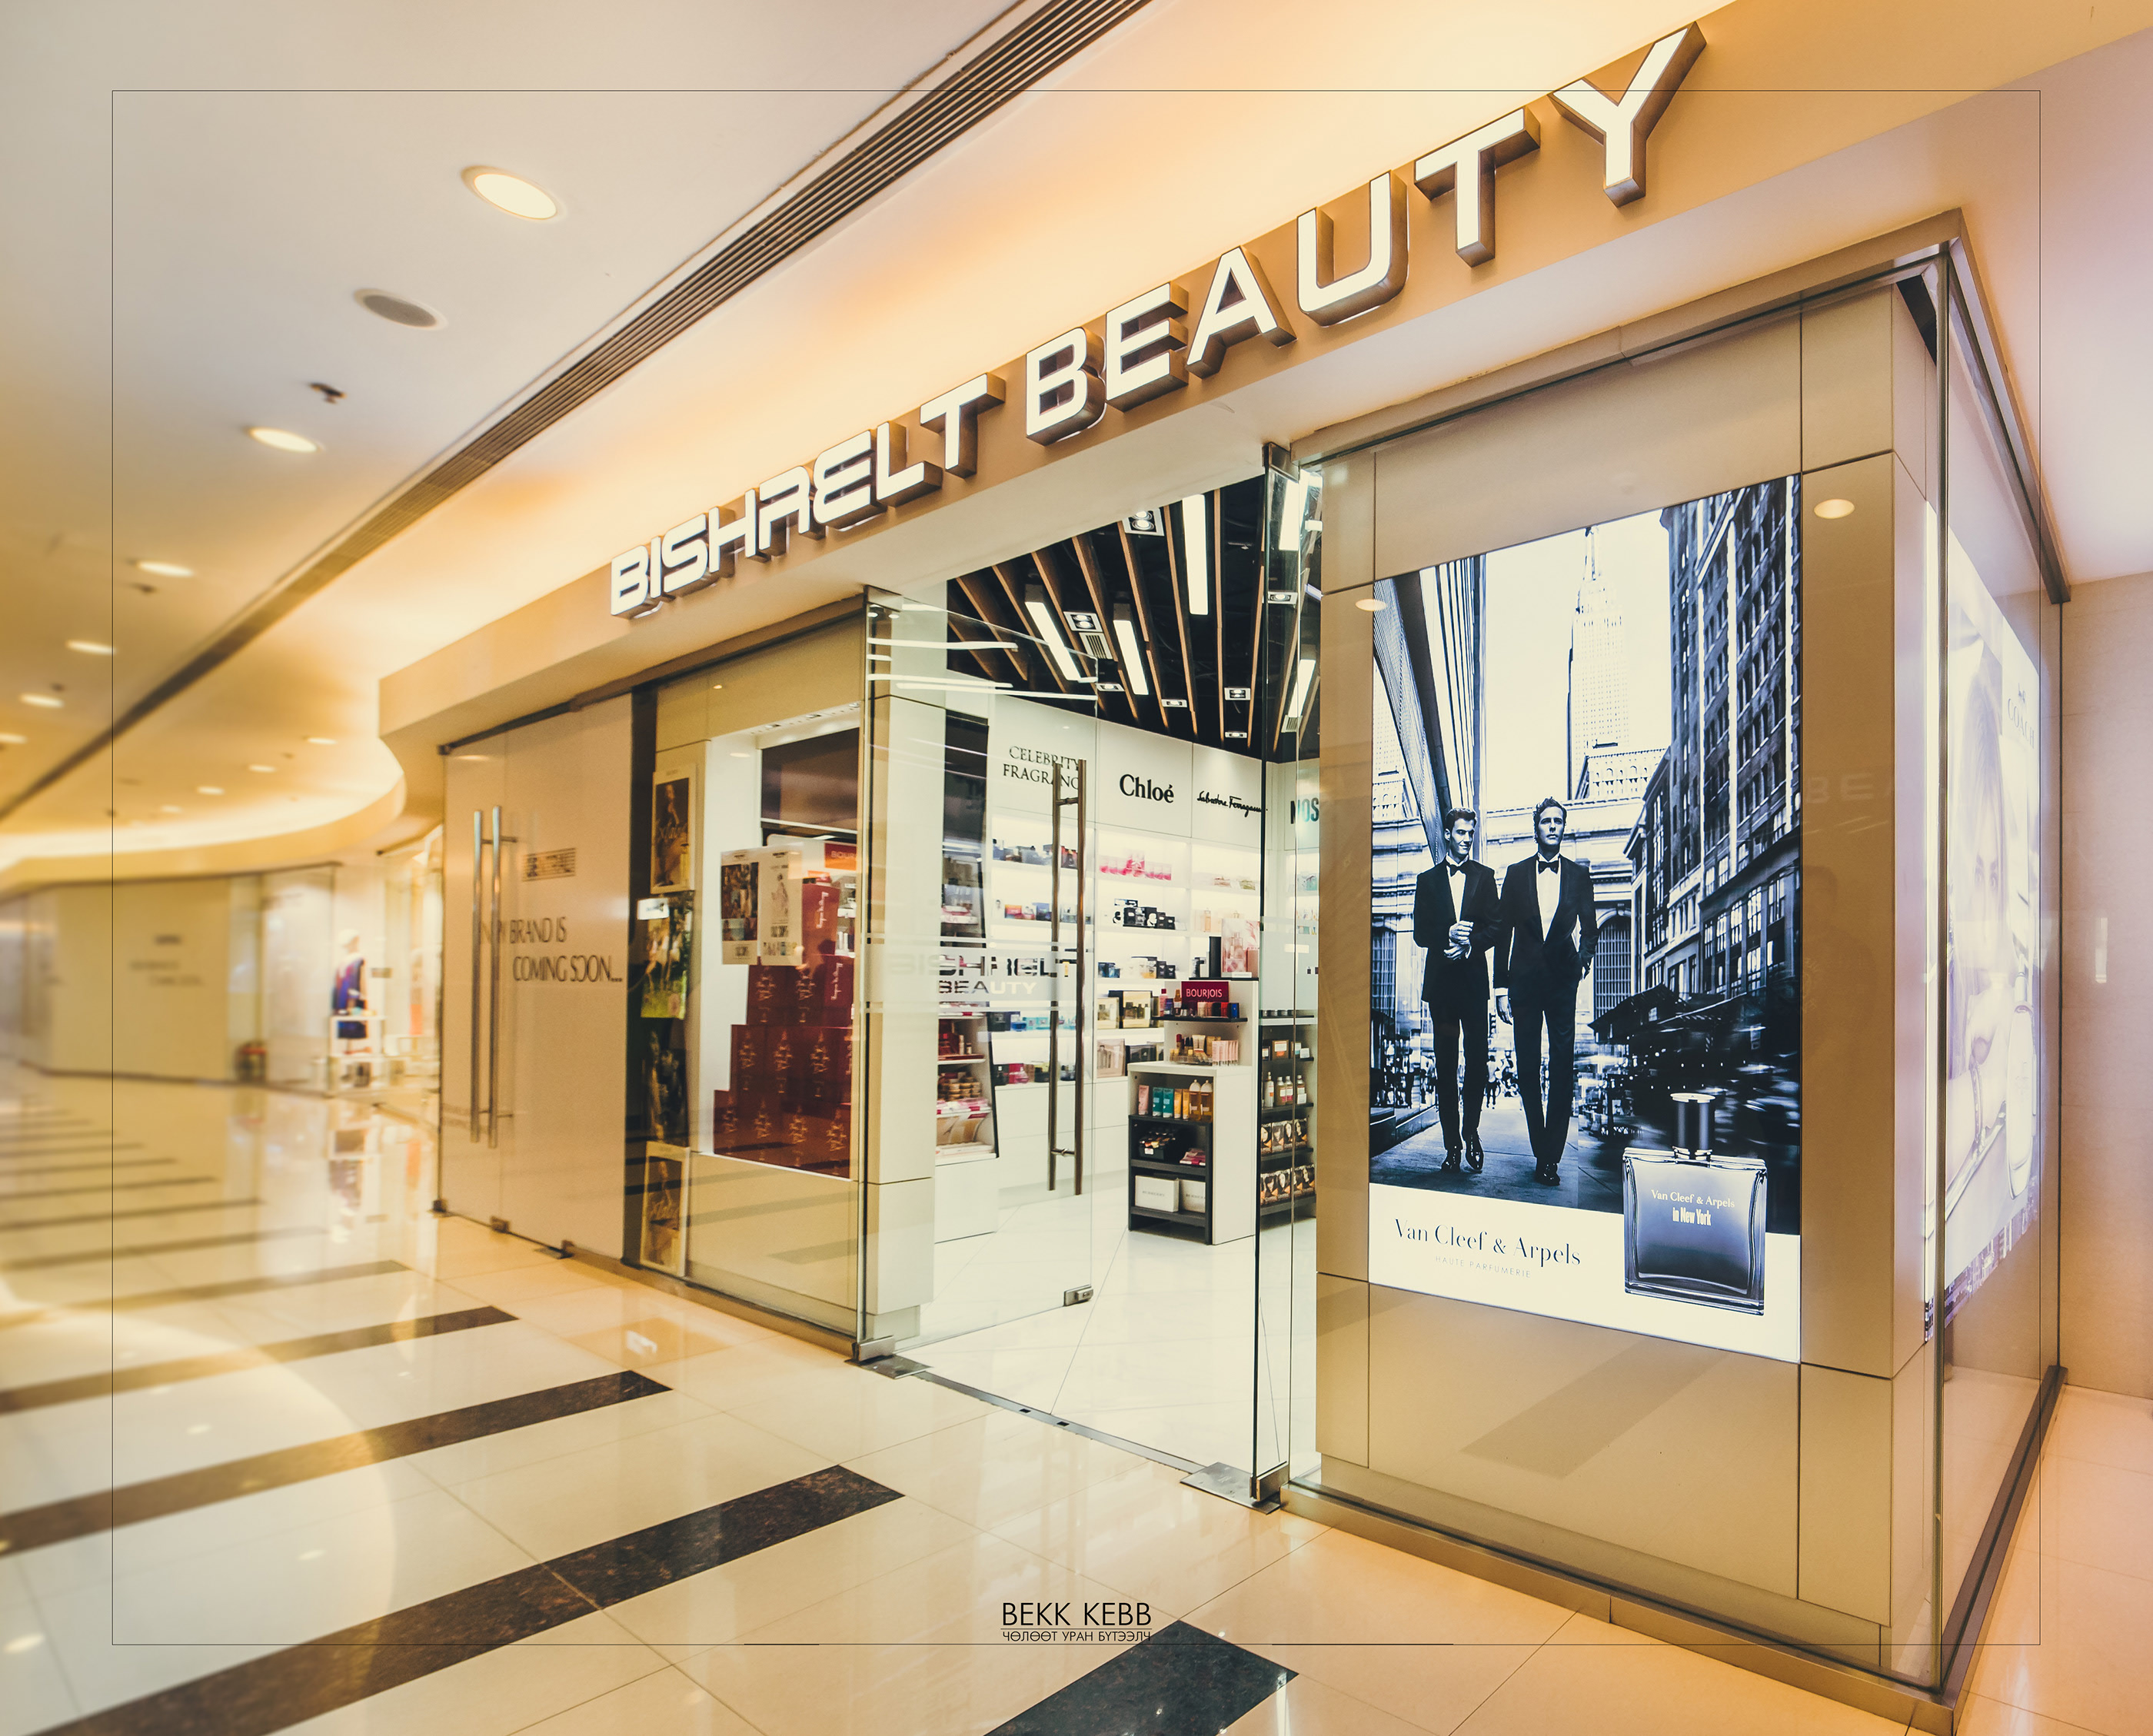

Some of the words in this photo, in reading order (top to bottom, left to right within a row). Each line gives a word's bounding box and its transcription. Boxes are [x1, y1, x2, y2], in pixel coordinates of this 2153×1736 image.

[611, 373, 1001, 617] BISHRELT
[1025, 22, 1704, 444] BEAUTY
[2008, 698, 2035, 749] COACH
[1009, 746, 1080, 771] CELEBRITY
[1119, 773, 1174, 803] Chloé
[509, 918, 553, 944] BRAND
[556, 916, 567, 943] IS
[512, 956, 567, 982] COMING
[938, 980, 1037, 995] BEAUTY
[1186, 989, 1223, 999] BOURJOIS
[1651, 1189, 1668, 1200] Van
[1670, 1192, 1694, 1203] Cleef
[1696, 1196, 1704, 1205] &
[1705, 1196, 1735, 1209] Arpels
[1672, 1207, 1679, 1222] in
[1680, 1207, 1695, 1224] New
[1695, 1209, 1712, 1226] York
[1394, 1218, 1429, 1242] Van
[1434, 1223, 1488, 1251] Cleef
[1492, 1239, 1507, 1255] &
[1513, 1236, 1581, 1268] Arpels
[1435, 1255, 1466, 1268] HAUTE
[1469, 1262, 1532, 1279] PARFUMERIE
